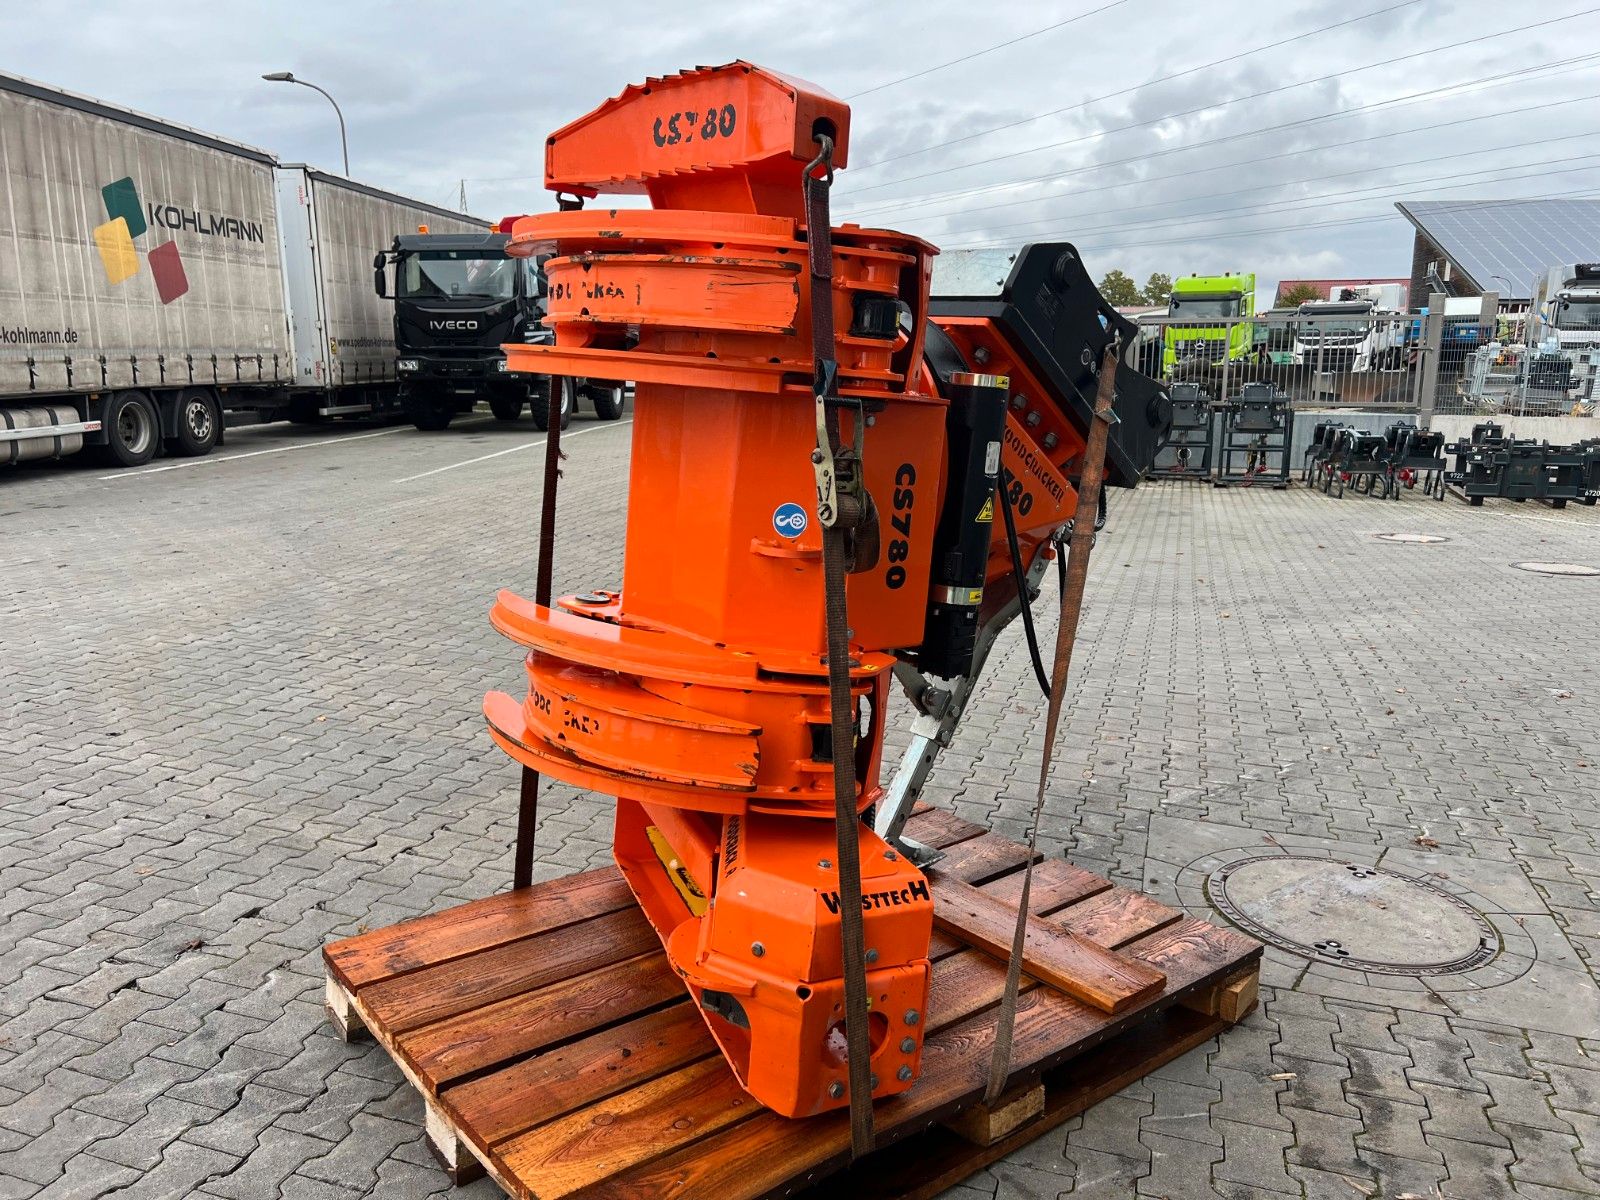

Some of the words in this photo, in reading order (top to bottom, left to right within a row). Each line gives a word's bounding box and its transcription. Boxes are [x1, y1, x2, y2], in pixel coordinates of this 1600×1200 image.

[148, 202, 264, 244] KOHLMANN
[429, 320, 478, 330] IVECO
[1003, 424, 1064, 503] OODCRACKER
[885, 463, 916, 590] CS780
[820, 880, 930, 915] WSTTECH
